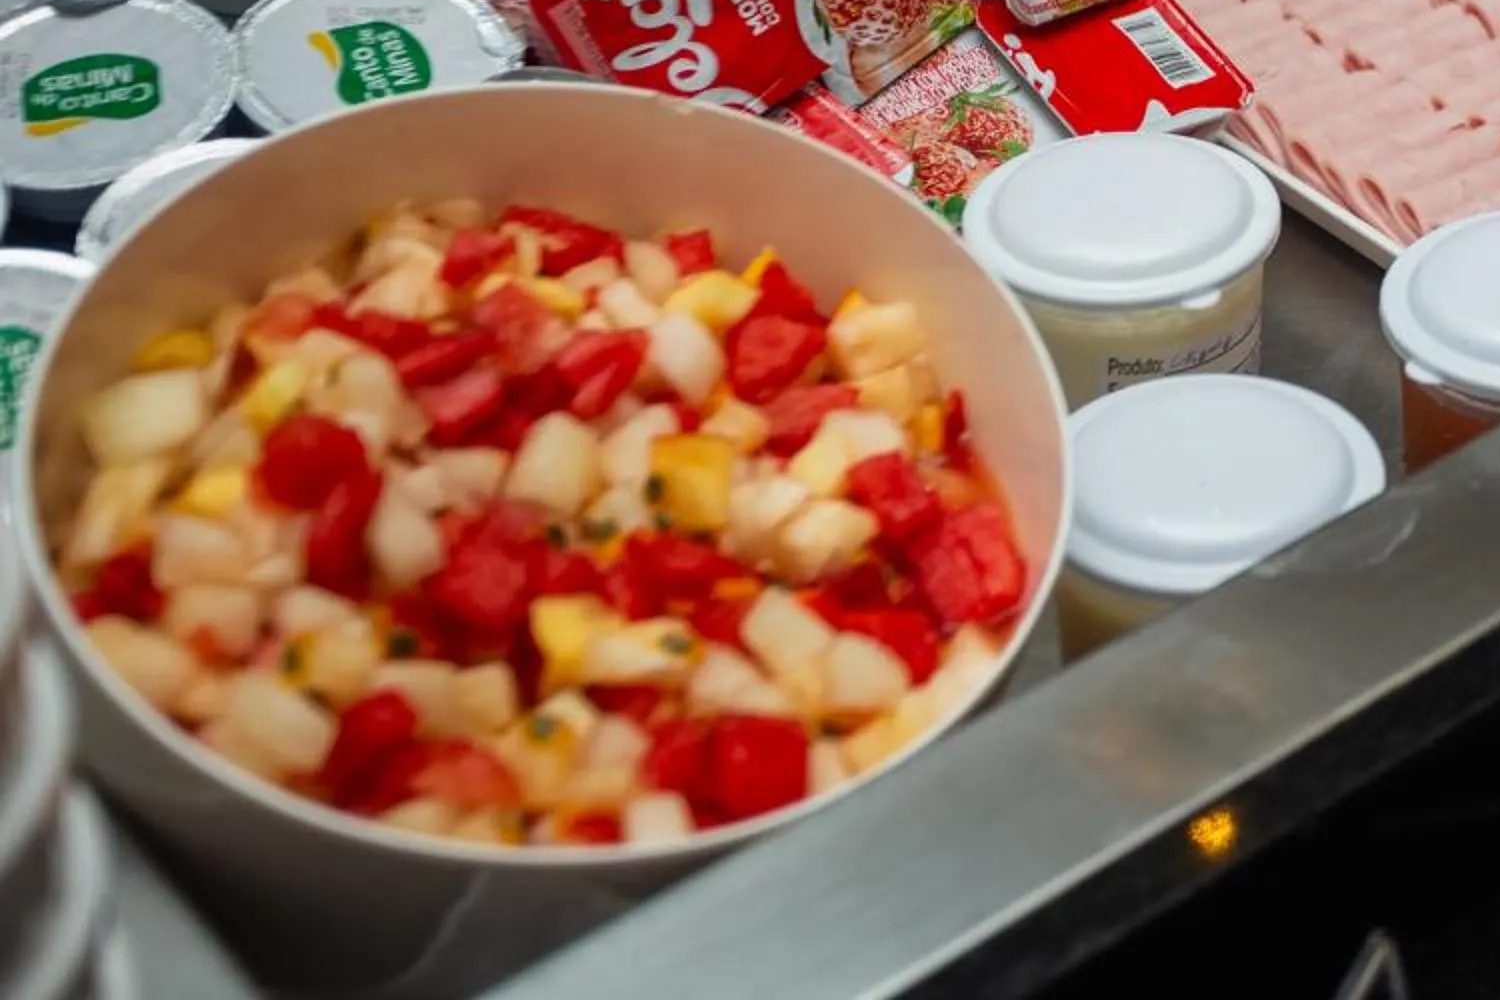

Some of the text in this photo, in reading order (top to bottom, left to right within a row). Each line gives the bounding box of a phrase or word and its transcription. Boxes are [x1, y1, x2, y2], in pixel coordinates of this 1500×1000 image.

[376, 29, 424, 87] Minas
[39, 64, 134, 91] Minas
[57, 82, 154, 111] Canto
